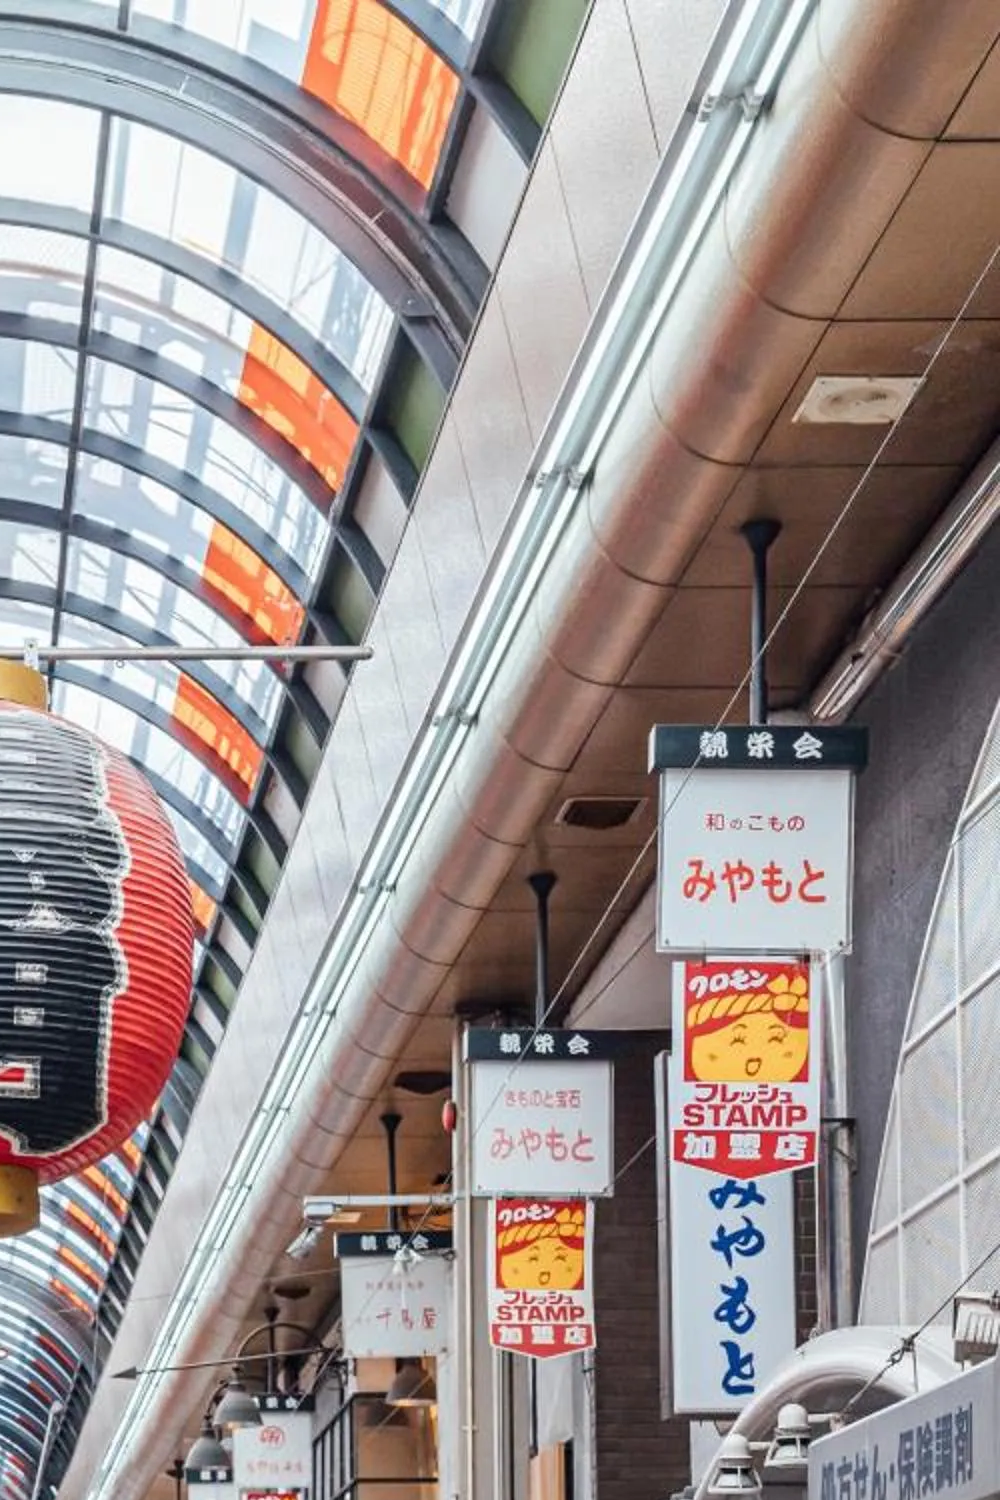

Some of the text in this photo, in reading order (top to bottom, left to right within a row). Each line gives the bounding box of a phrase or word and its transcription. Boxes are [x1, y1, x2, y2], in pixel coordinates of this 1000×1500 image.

[704, 813, 806, 833] 和のこもの
[683, 858, 827, 904] みやもと
[688, 969, 769, 998] クロモン
[695, 1083, 793, 1104] フレッシュ
[683, 1103, 808, 1128] STAMP
[490, 1126, 595, 1163] みやもと
[682, 1131, 809, 1160] 加盟店
[498, 1203, 556, 1226] クロモン
[708, 1178, 766, 1396] みやもと
[497, 1305, 586, 1322] STAMP
